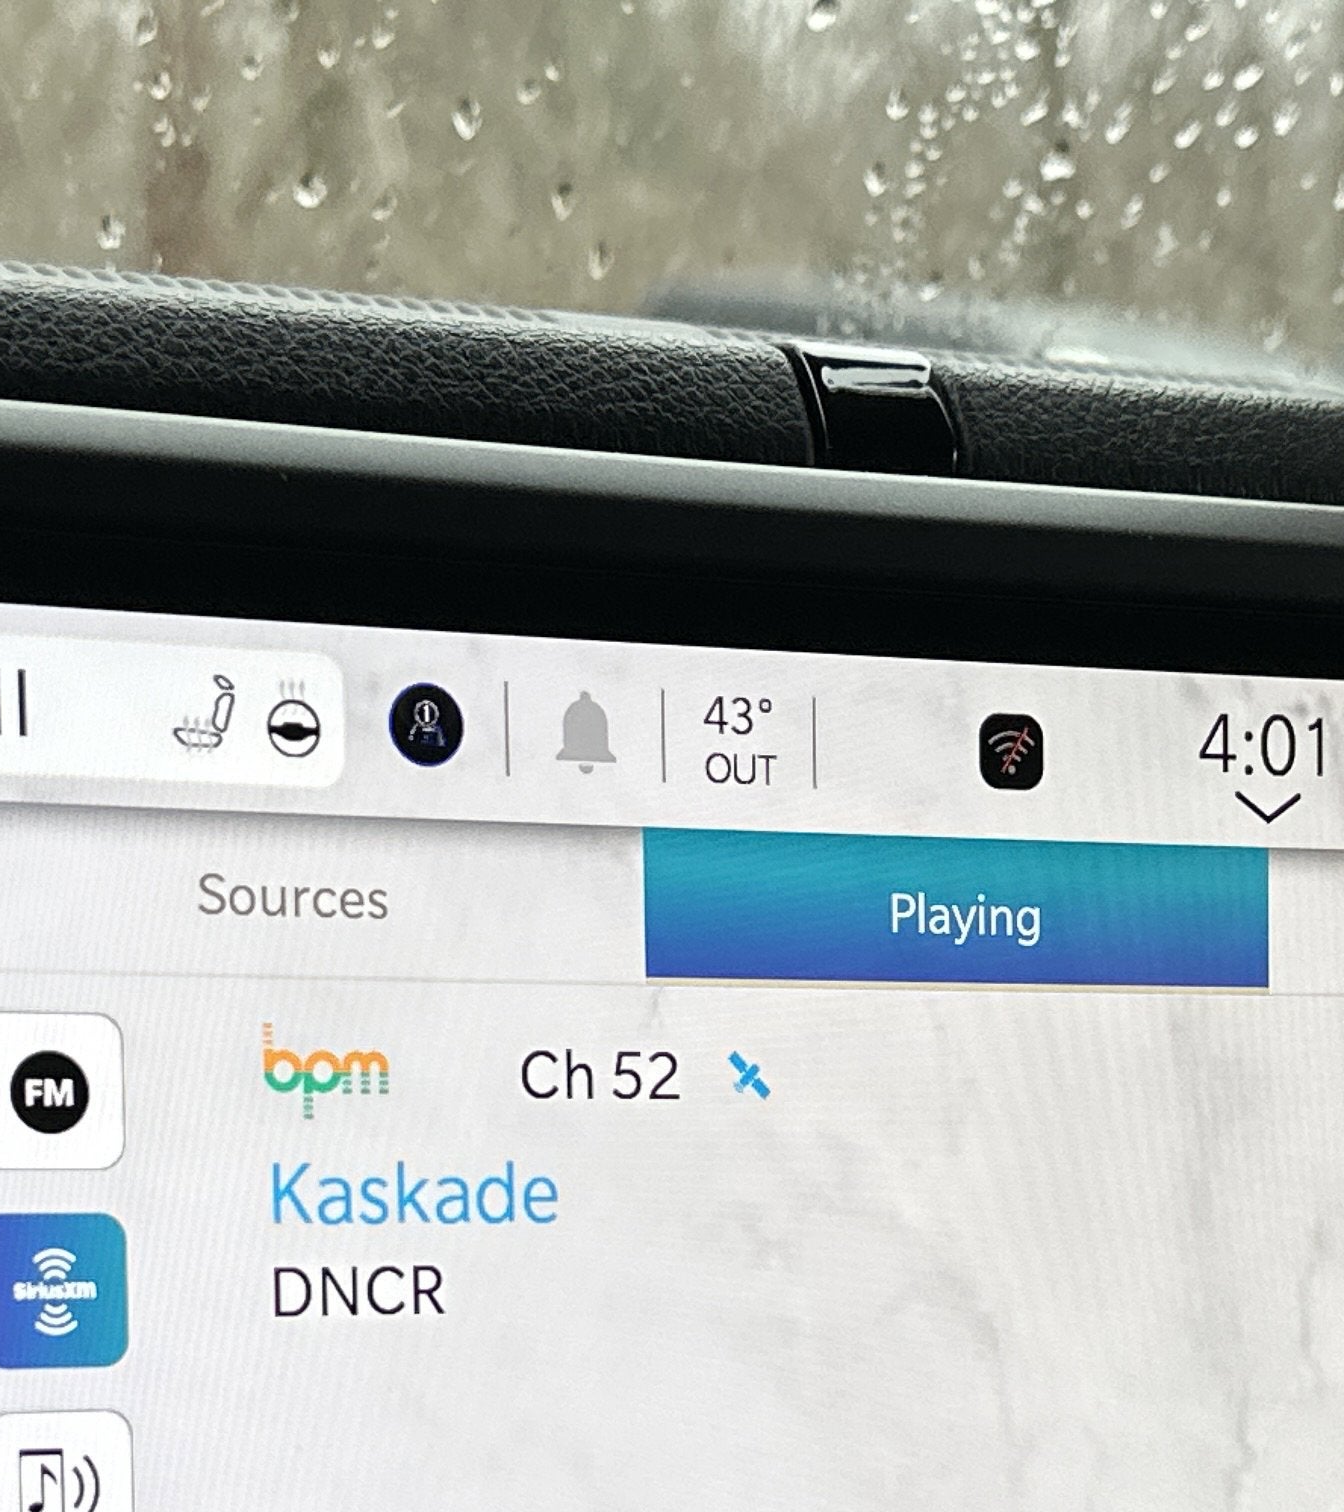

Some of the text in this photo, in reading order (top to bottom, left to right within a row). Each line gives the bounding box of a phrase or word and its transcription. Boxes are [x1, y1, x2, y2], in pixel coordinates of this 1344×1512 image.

[704, 696, 772, 735] 43°
[705, 752, 777, 786] OUT
[1199, 713, 1324, 777] 4:01
[198, 872, 388, 919] Sources
[890, 891, 1042, 946] Playing
[24, 1079, 74, 1108] FM
[262, 1022, 389, 1119] bpm
[521, 1048, 680, 1100] Ch 52
[272, 1160, 559, 1225] Kaskade
[274, 1265, 445, 1317] DNCR
